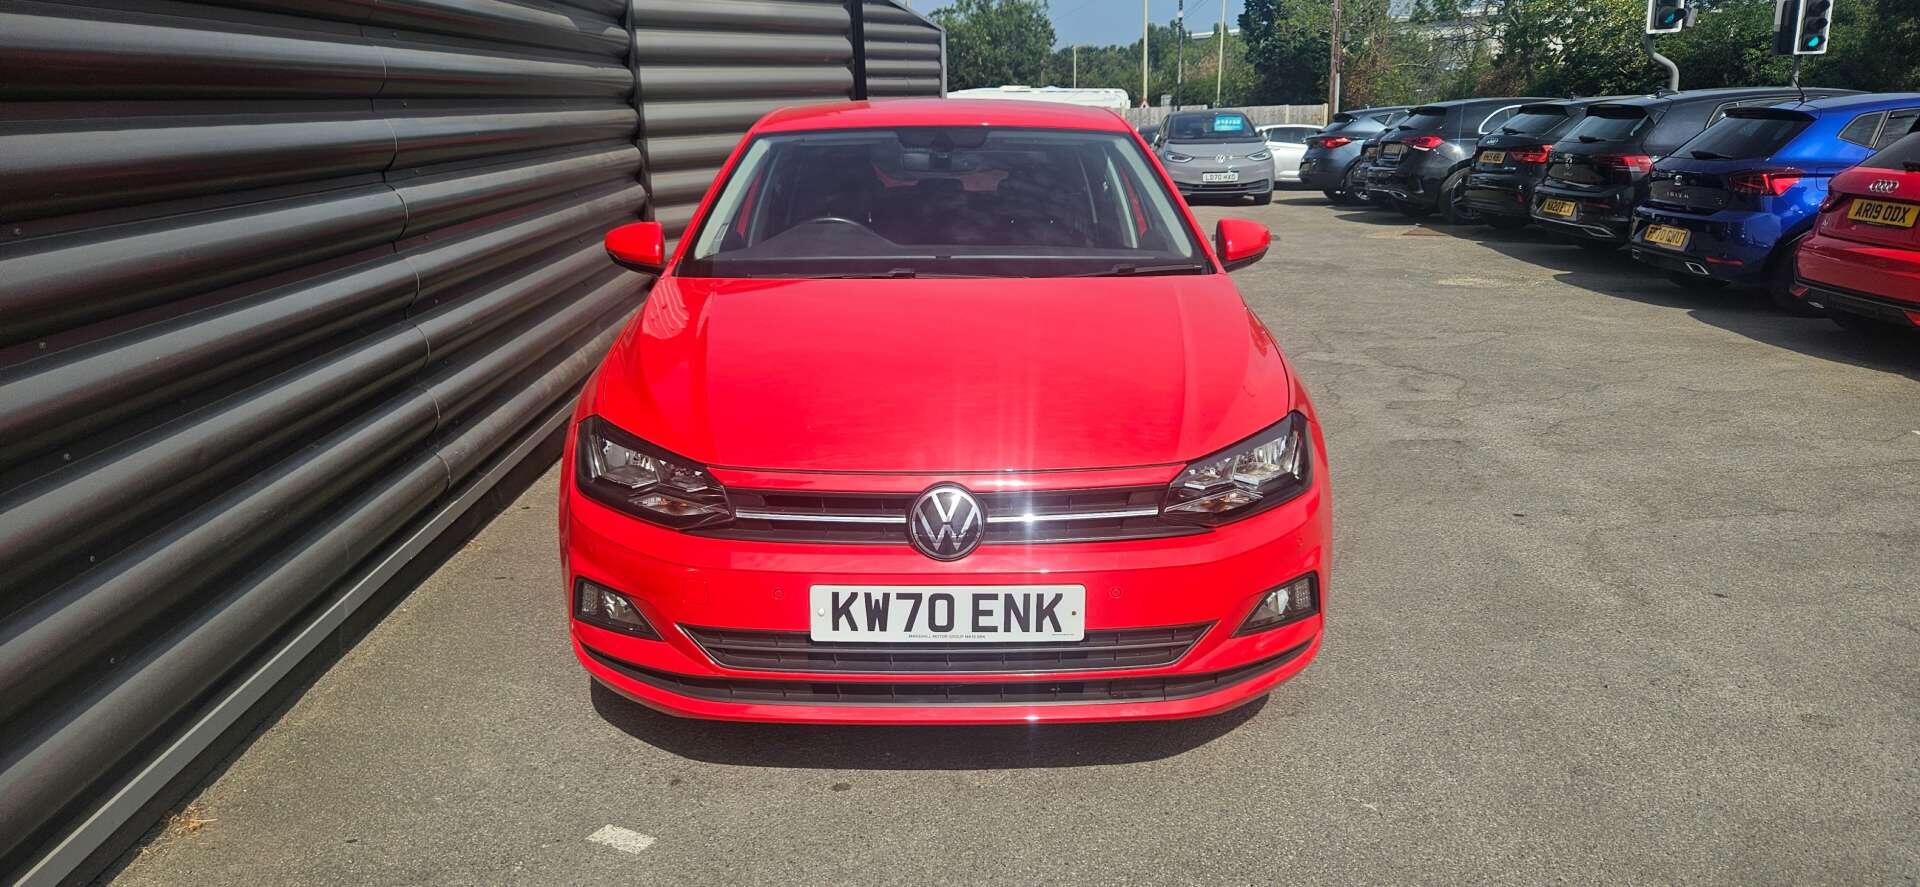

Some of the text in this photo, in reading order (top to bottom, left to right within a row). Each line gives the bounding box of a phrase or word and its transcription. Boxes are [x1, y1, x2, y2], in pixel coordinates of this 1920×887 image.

[1854, 200, 1911, 223] AR19 ODX
[831, 591, 1063, 632] KW70 ENK
